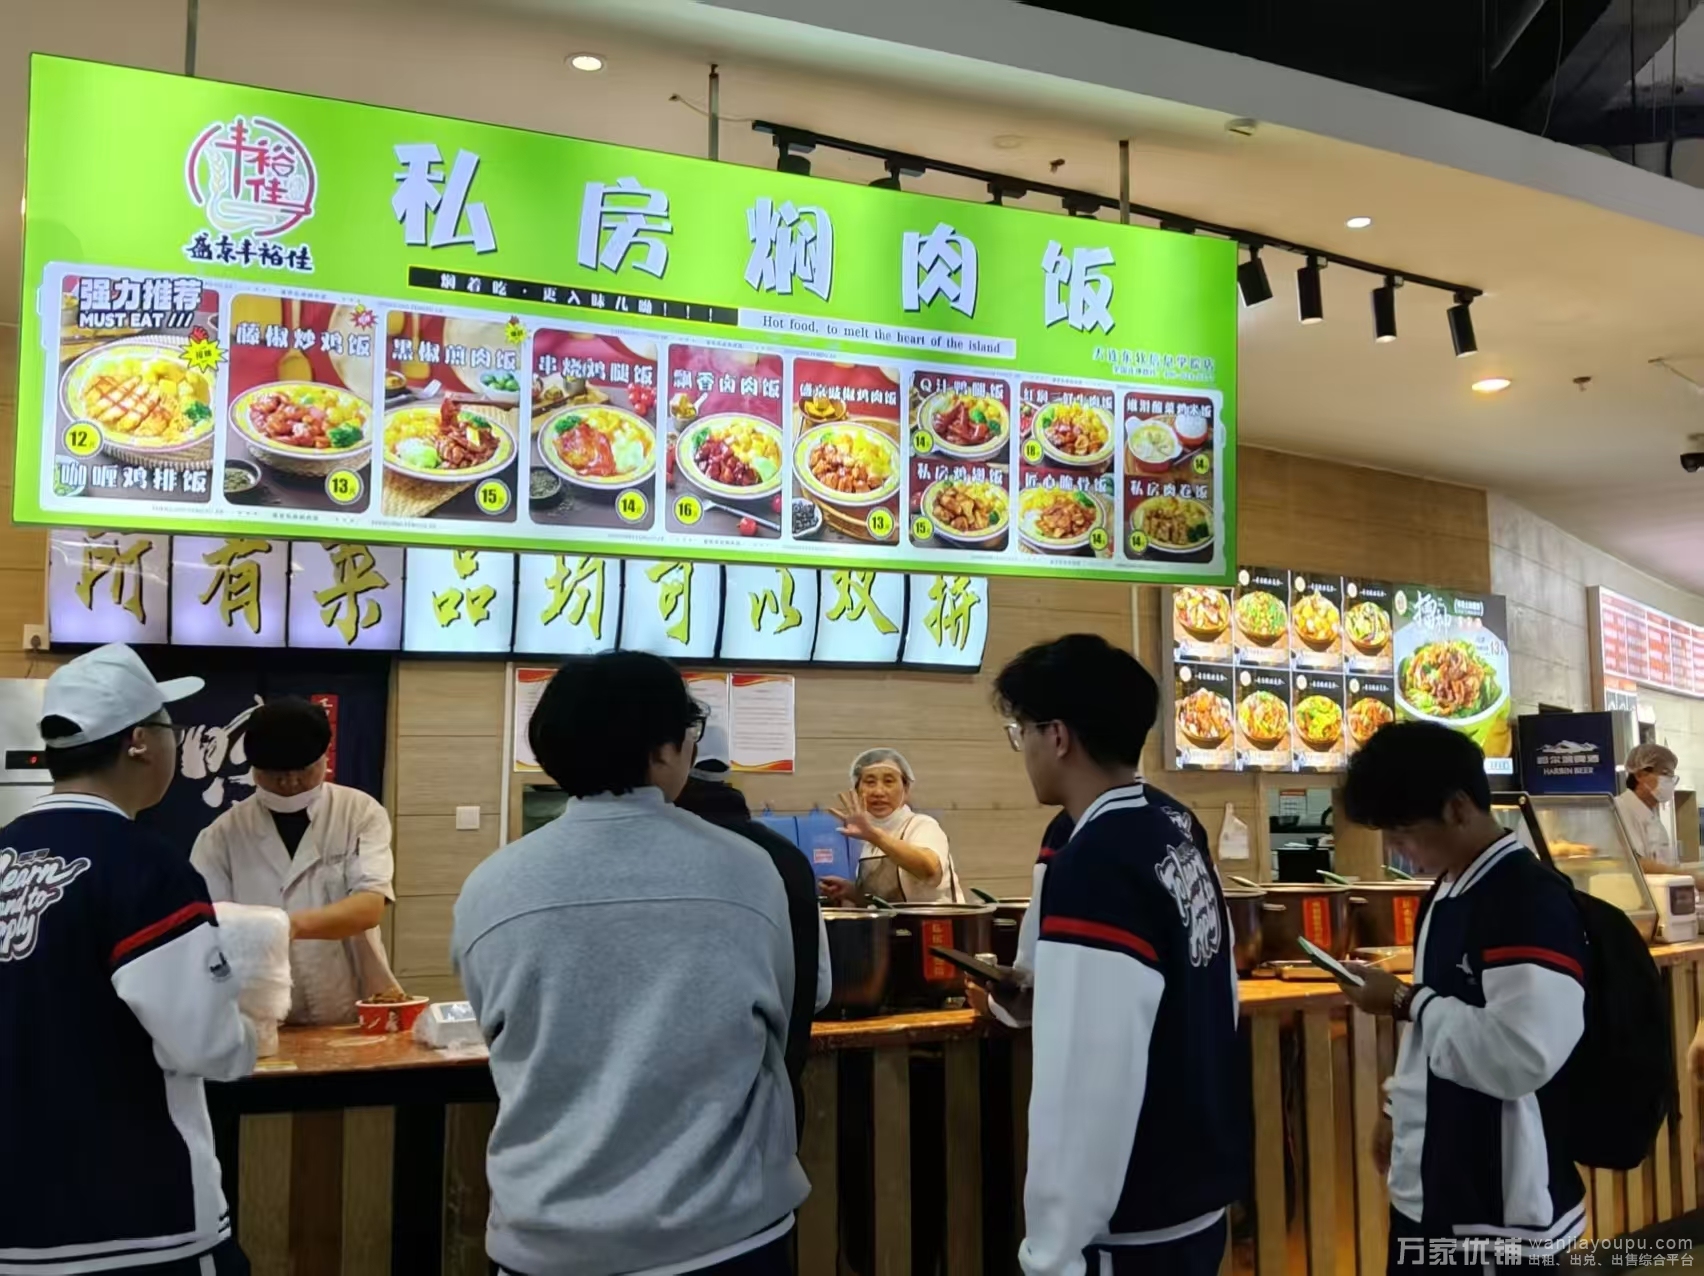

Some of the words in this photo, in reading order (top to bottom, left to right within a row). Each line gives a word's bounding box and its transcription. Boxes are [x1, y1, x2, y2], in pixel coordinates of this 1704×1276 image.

[187, 233, 313, 270] 盛京丰裕佳
[391, 143, 1116, 335] 私房焖肉饭
[80, 278, 201, 311] 强力推荐
[80, 313, 125, 327] MUST
[131, 313, 164, 327] EAT
[763, 315, 784, 329] Hot
[826, 324, 838, 335] to
[844, 326, 870, 339] melt
[874, 328, 892, 341] the
[897, 331, 925, 345] heart
[931, 335, 943, 347] of
[946, 337, 963, 350] the
[968, 340, 1001, 353] island
[539, 354, 653, 385] 串烧鸡腿饭
[673, 369, 779, 398] 飘香卤肉饭
[60, 462, 207, 493] 咖喱鸡排饭
[74, 534, 980, 649] 所有菜品均可以双拼
